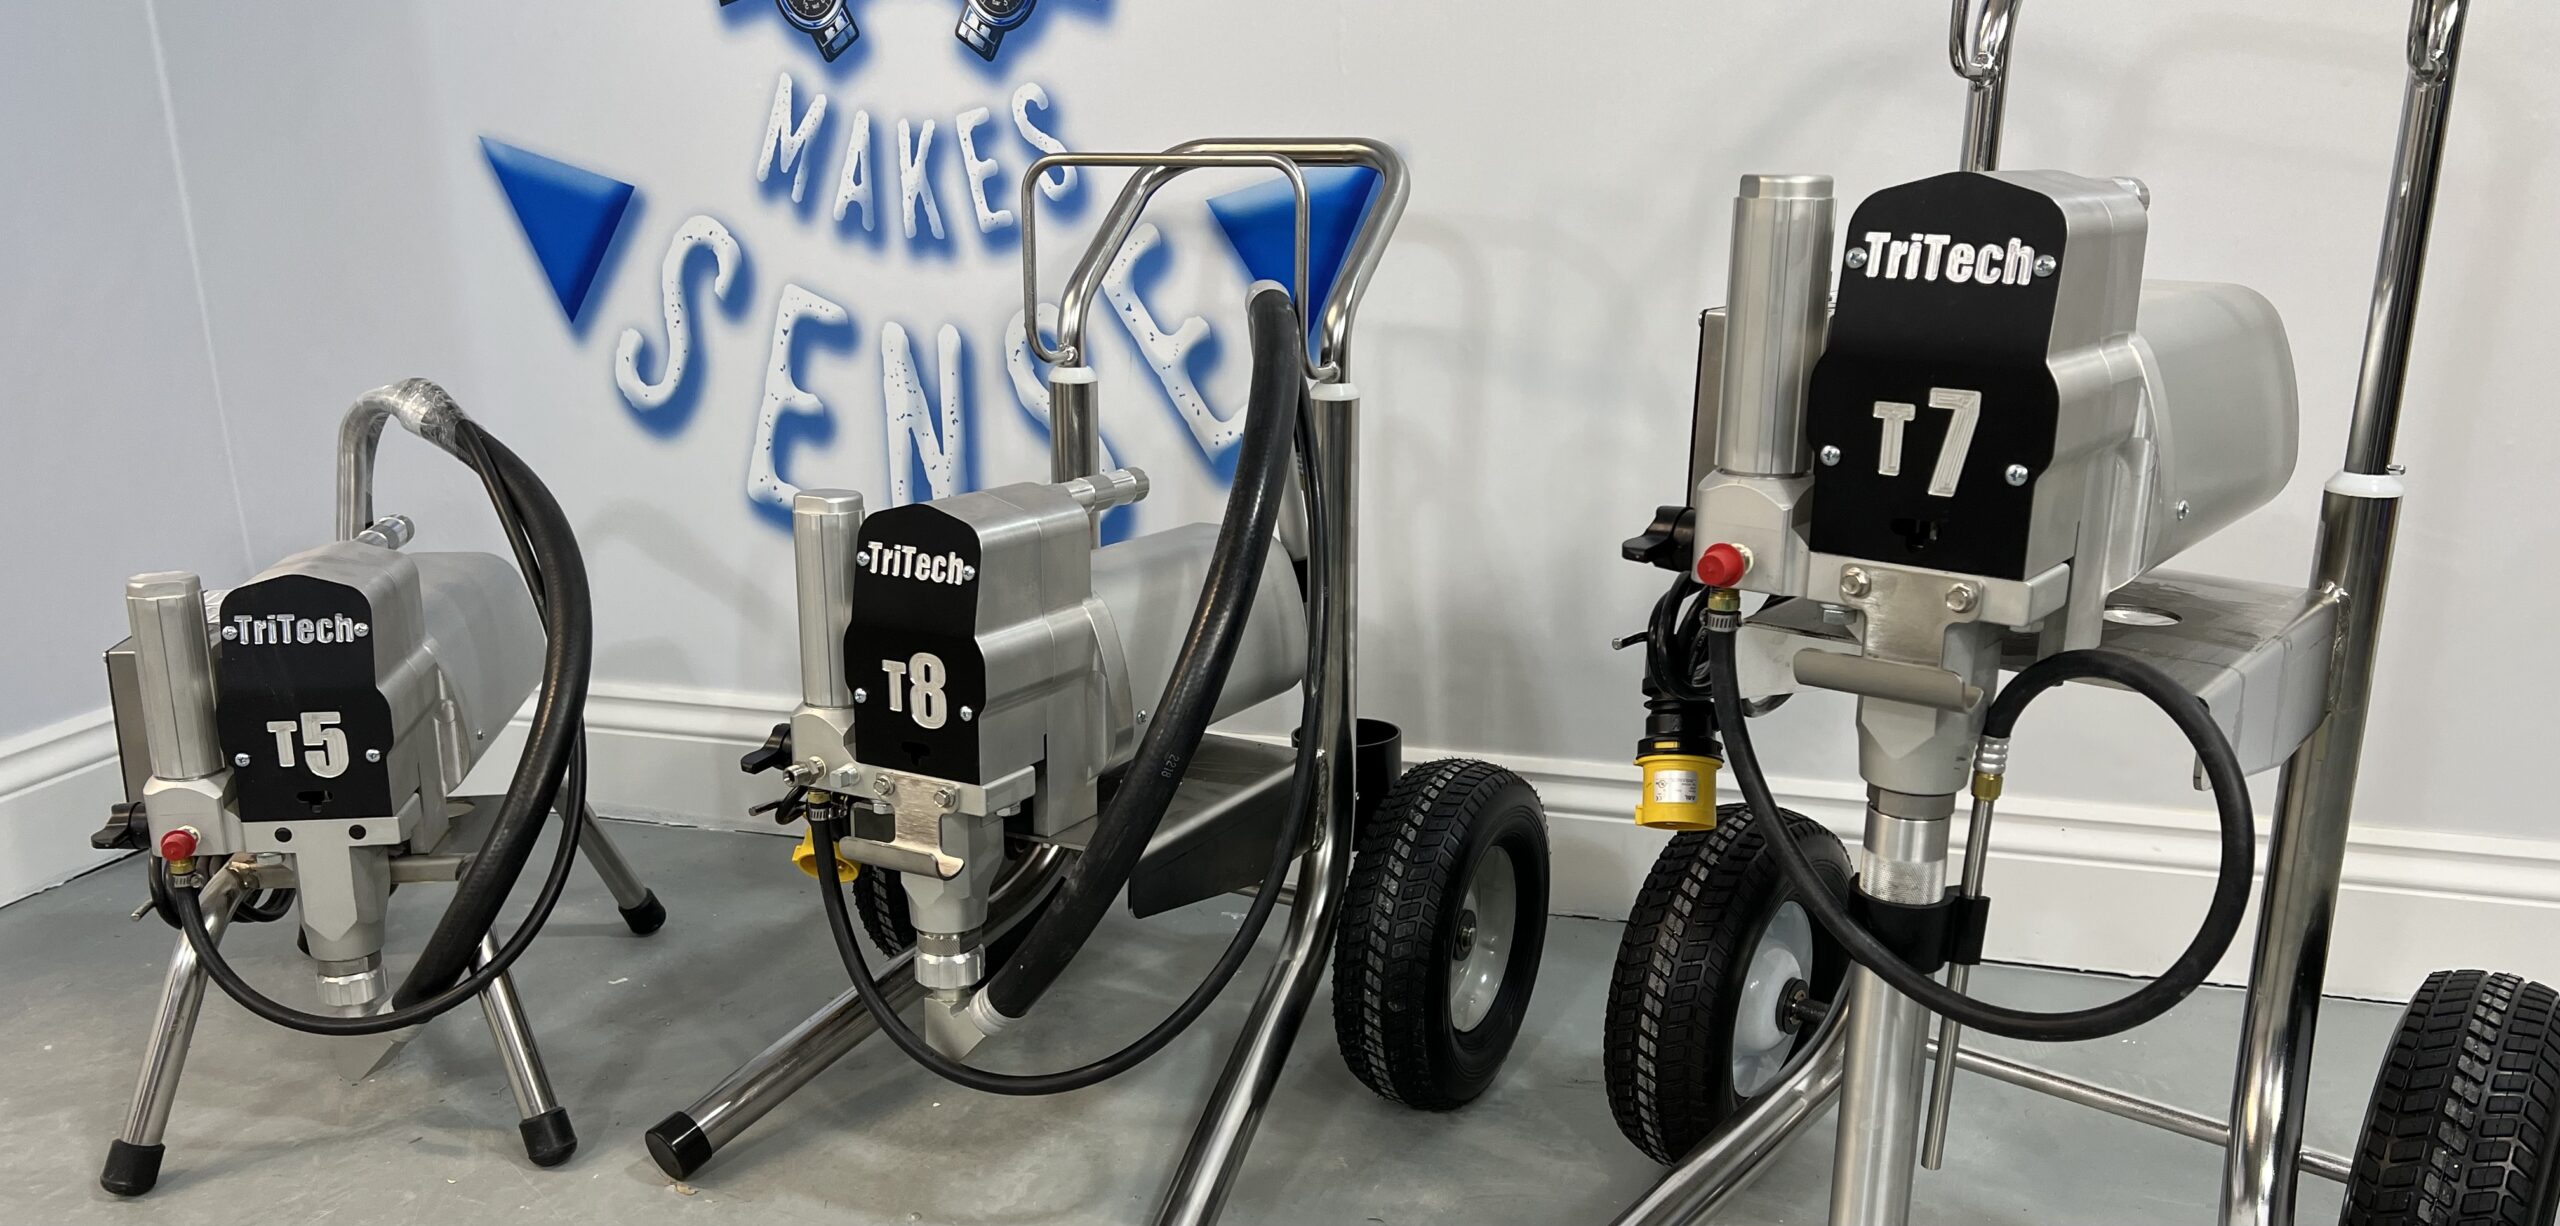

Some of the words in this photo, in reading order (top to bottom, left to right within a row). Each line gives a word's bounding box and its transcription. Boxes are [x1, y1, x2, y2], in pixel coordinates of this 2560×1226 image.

[757, 73, 1078, 238] MAKES
[1864, 231, 2034, 286] TriTech
[1873, 387, 1982, 498] T7
[867, 541, 965, 586] TriTech
[233, 613, 355, 645] TriTech
[881, 652, 947, 730] T8
[266, 711, 350, 779] T5
